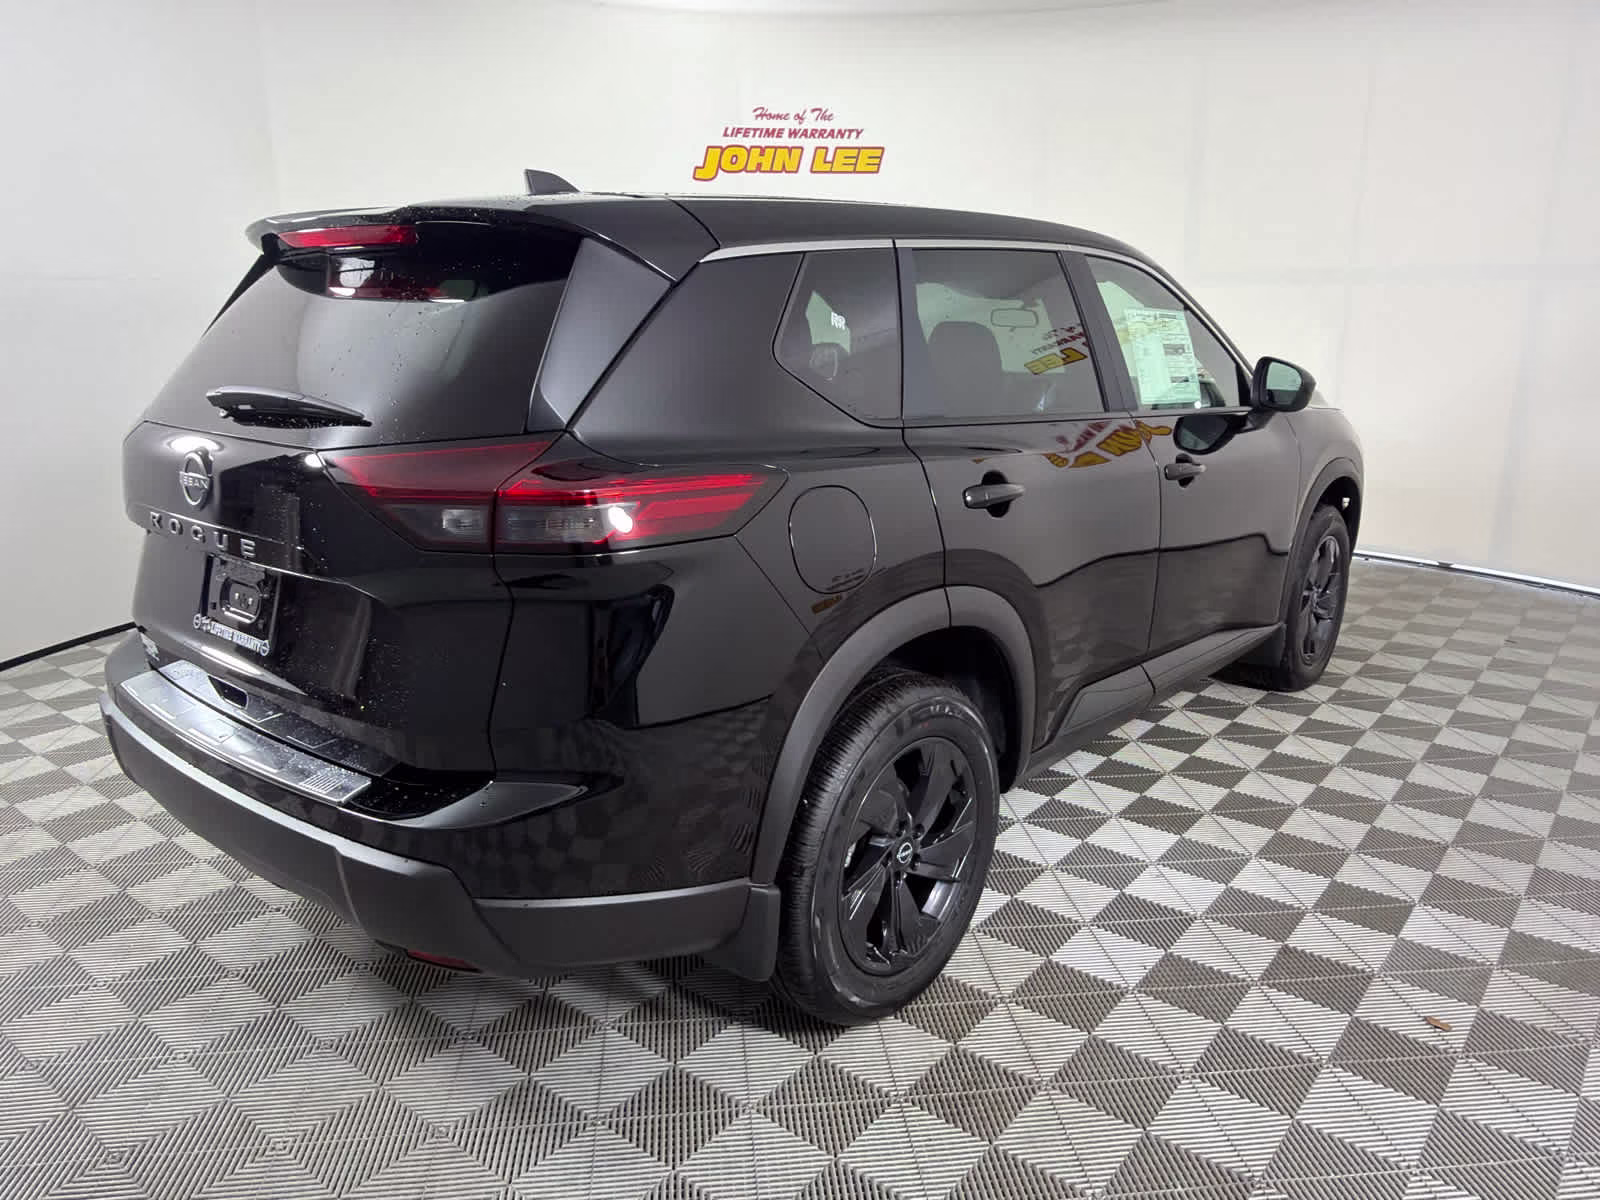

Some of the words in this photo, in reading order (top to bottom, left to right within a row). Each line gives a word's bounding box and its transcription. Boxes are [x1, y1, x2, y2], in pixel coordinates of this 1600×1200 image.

[752, 106, 790, 121] Home
[793, 109, 807, 124] of
[810, 108, 834, 122] The
[722, 127, 785, 138] LIFETIME
[788, 128, 864, 139] WARRANTY
[693, 145, 804, 181] JOHN
[810, 146, 885, 174] LEE
[180, 471, 210, 490] SSAN
[150, 511, 256, 558] ROGUE
